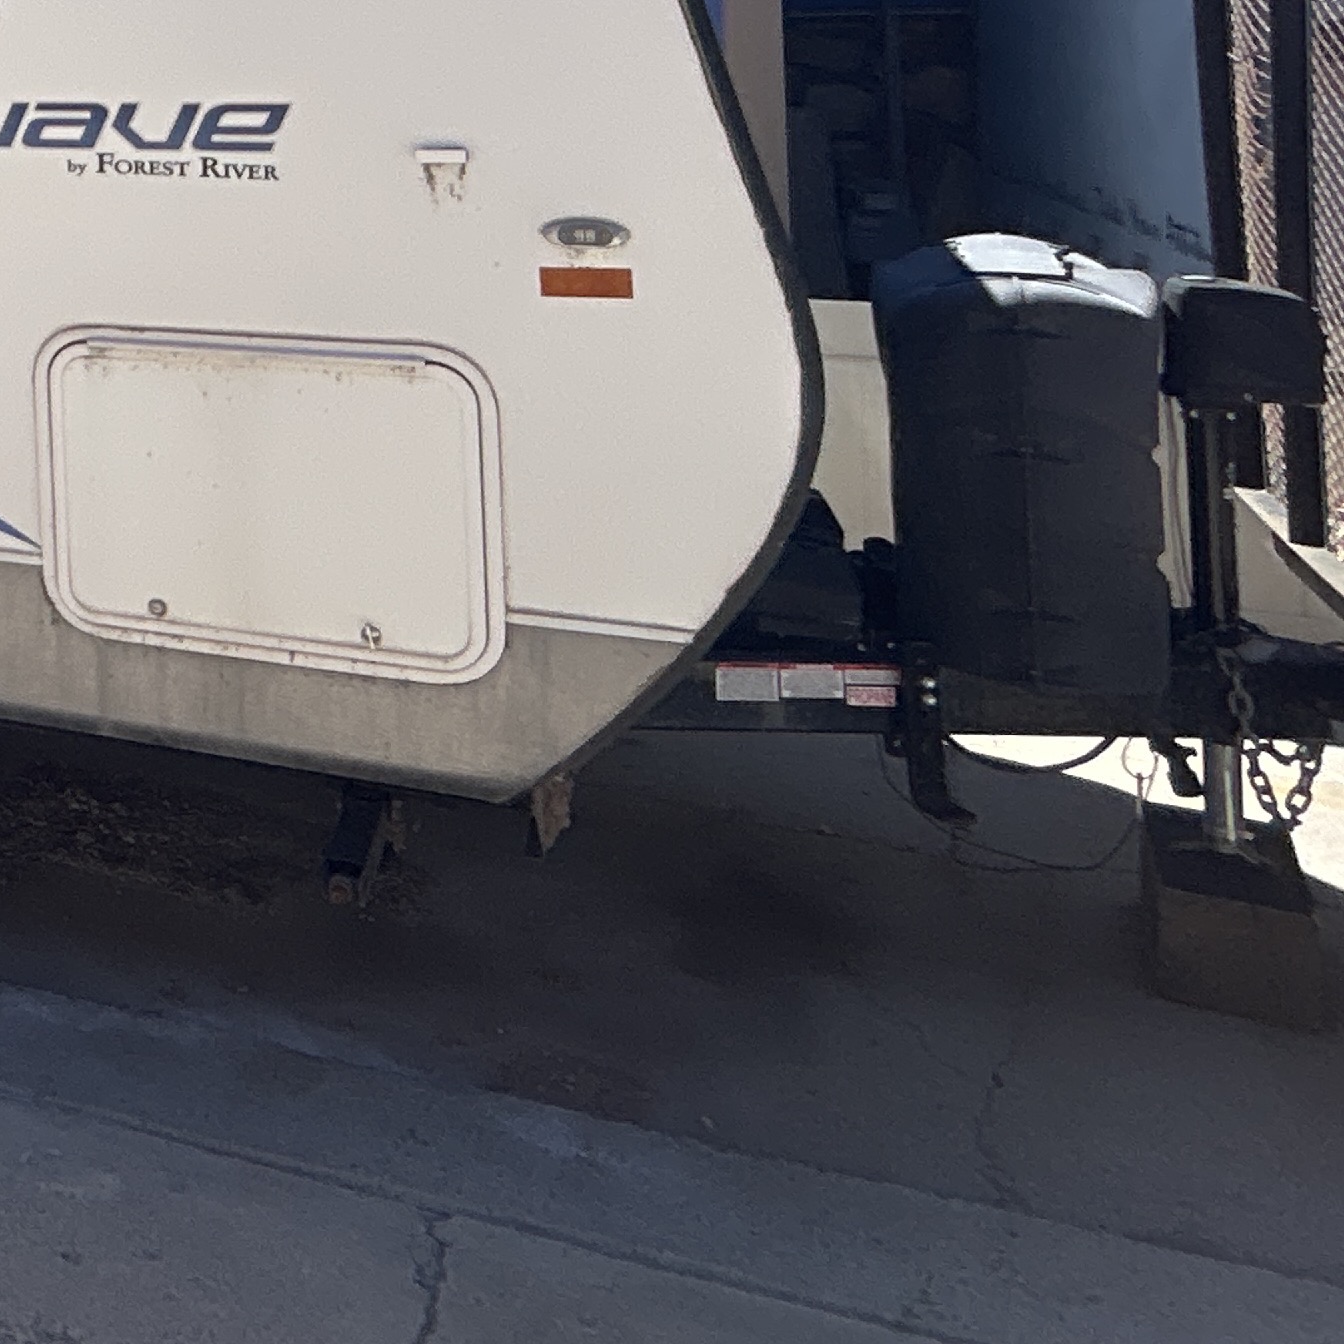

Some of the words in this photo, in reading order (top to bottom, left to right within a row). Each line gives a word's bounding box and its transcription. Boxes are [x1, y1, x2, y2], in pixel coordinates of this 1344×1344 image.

[66, 159, 86, 176] by
[95, 152, 191, 177] FOREST
[199, 156, 280, 181] RIVER
